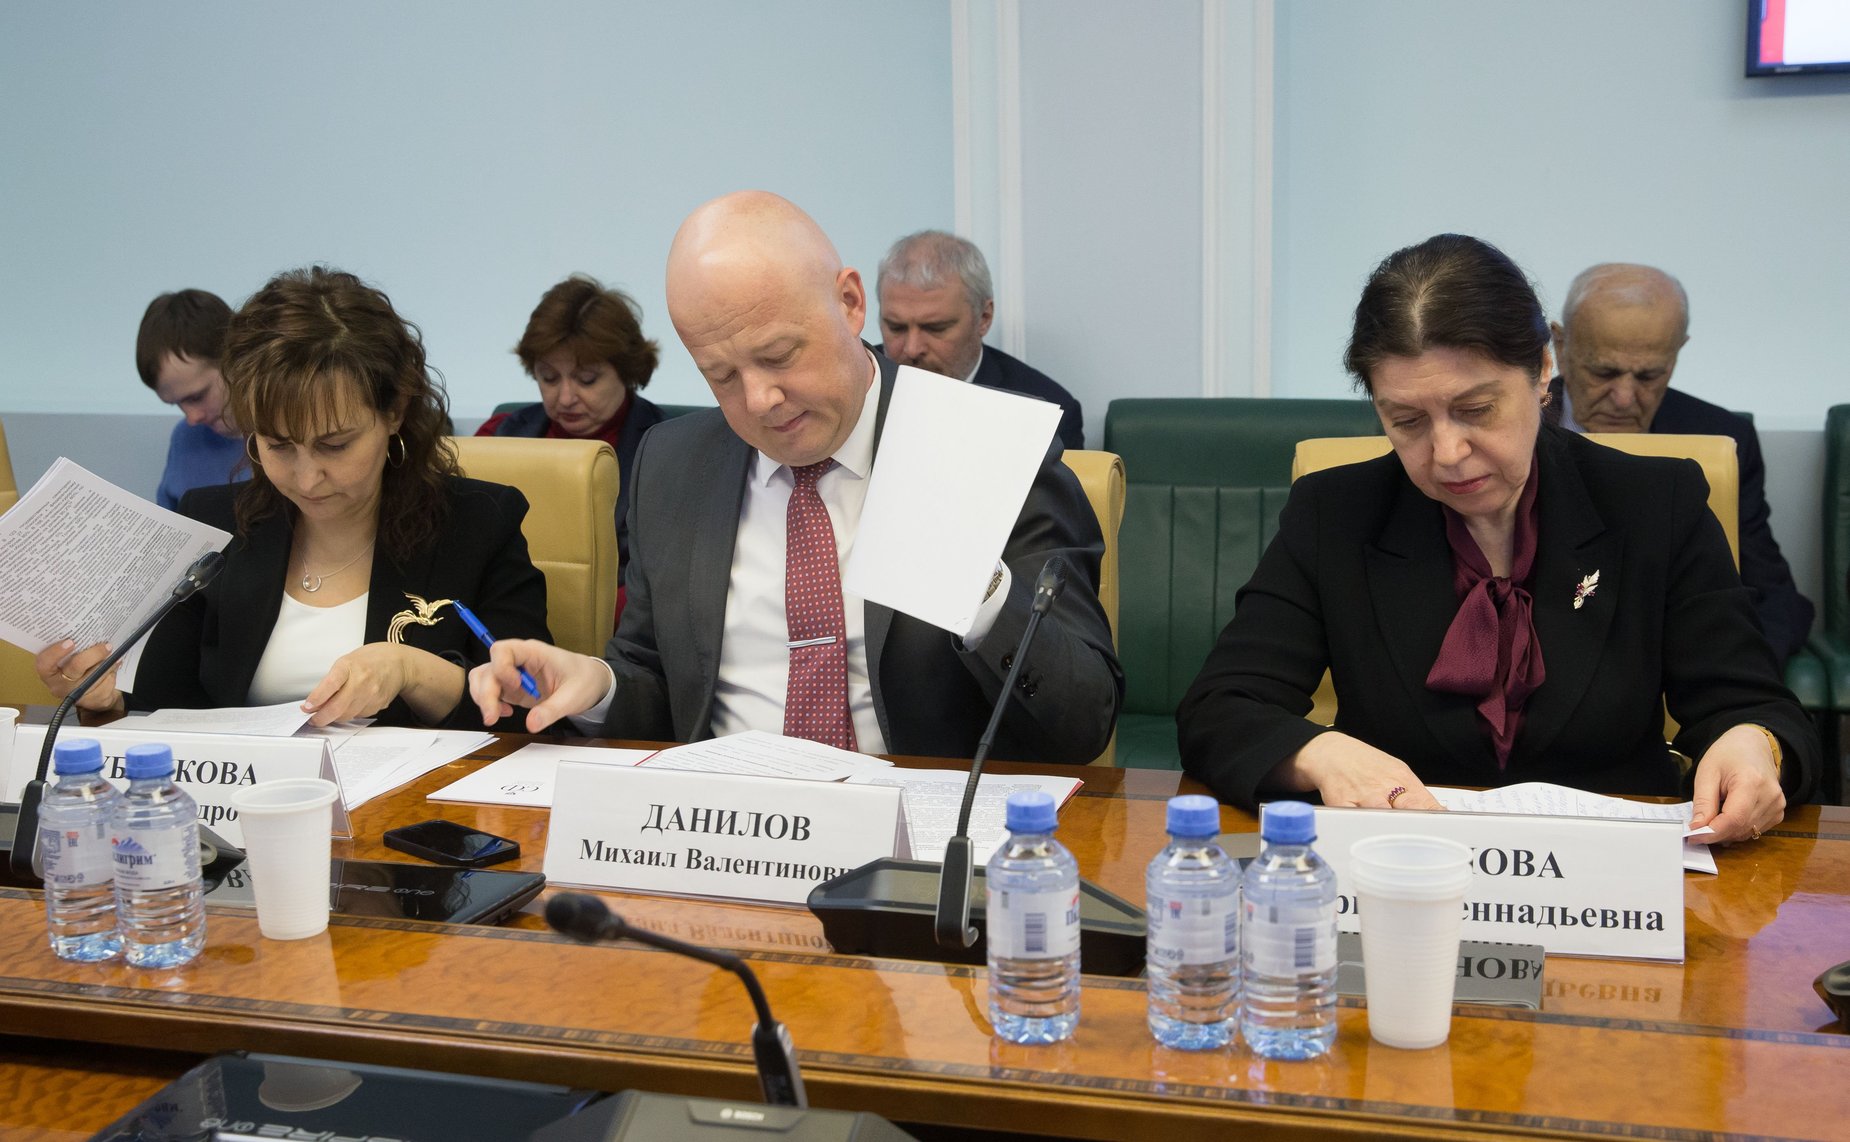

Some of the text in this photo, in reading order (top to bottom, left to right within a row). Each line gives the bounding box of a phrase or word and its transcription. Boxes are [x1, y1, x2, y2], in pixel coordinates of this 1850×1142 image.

[95, 755, 257, 786] БКОВА
[640, 803, 812, 842] ДАНИЛОВ
[579, 838, 855, 882] Михаил Валентинов
[1461, 901, 1665, 932] ннадьевна
